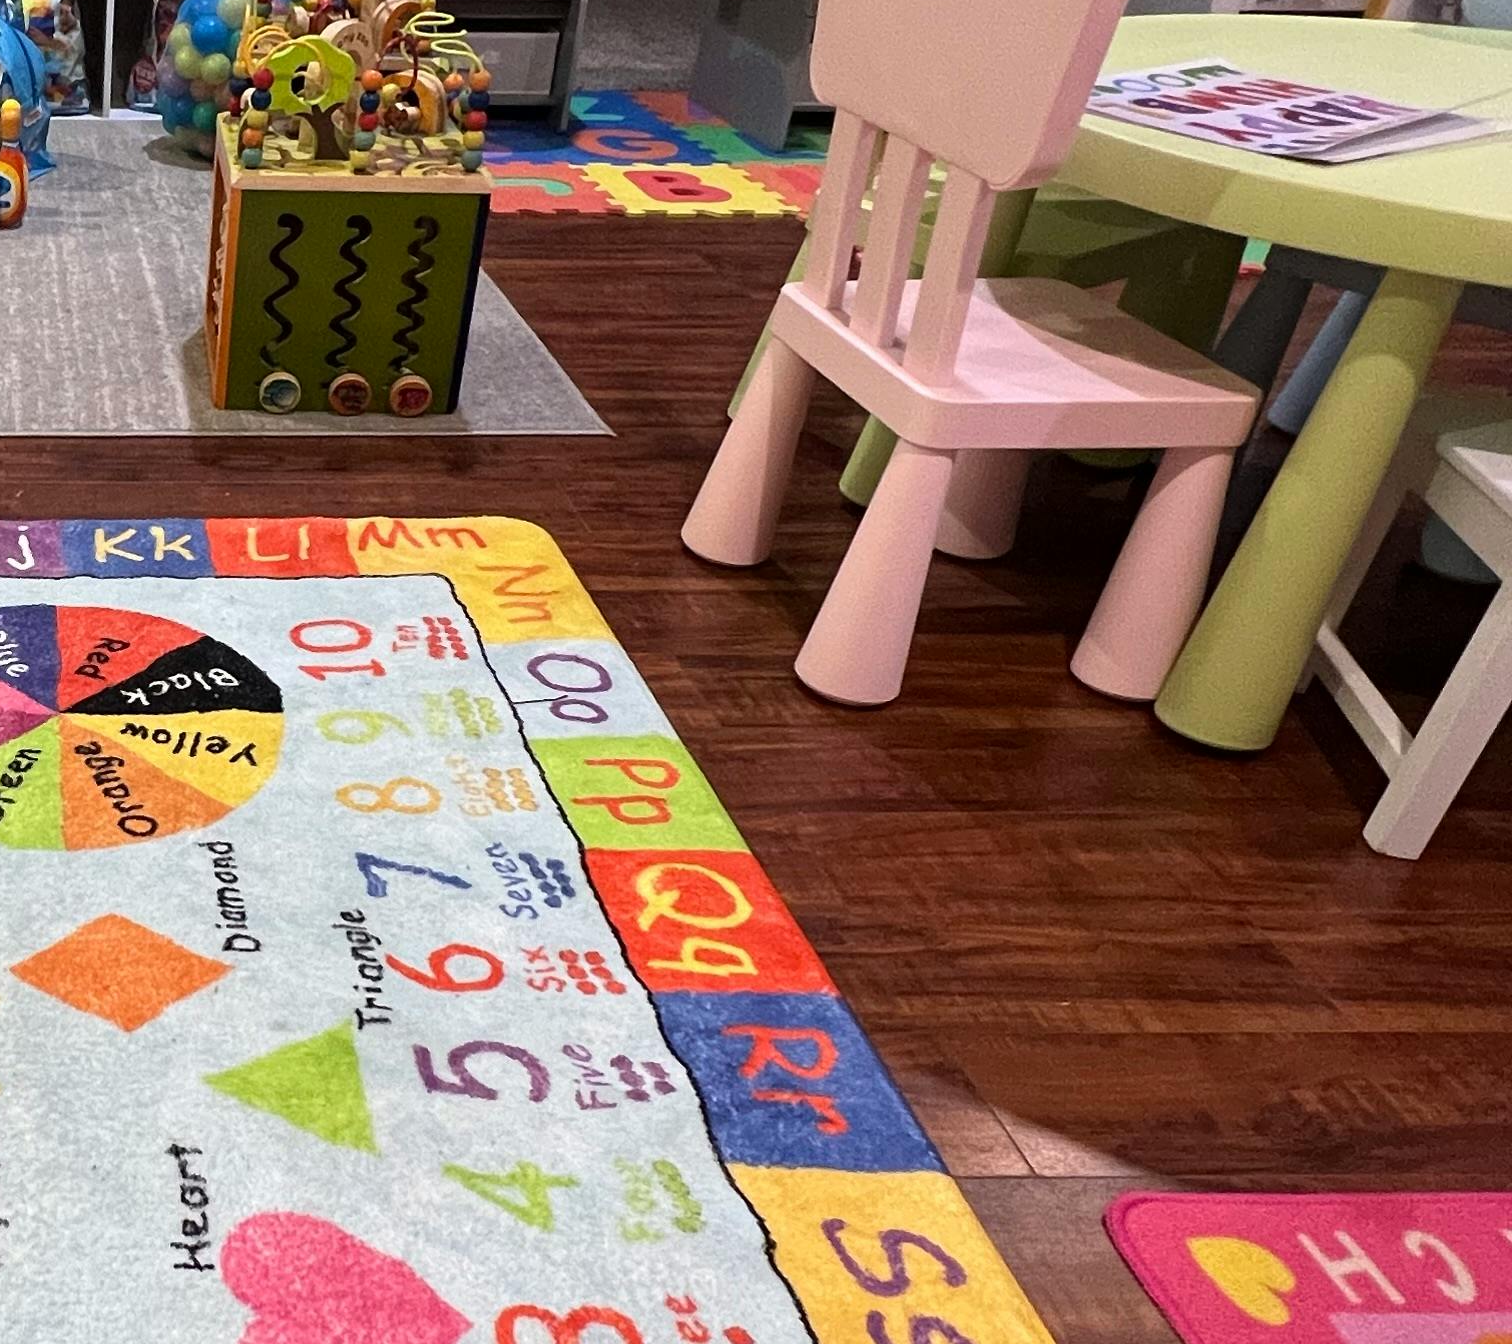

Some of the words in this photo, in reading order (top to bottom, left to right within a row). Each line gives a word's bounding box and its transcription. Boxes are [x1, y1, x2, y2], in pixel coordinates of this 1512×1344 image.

[572, 128, 680, 160] G
[622, 170, 732, 203] B
[93, 526, 197, 562] Kk
[357, 519, 489, 552] Mm
[476, 563, 561, 625] Nn
[74, 637, 130, 681] Red
[289, 618, 389, 681] 10
[392, 623, 421, 653] Ten
[121, 666, 241, 706] Black
[526, 652, 613, 725] Oo
[120, 721, 260, 768] Yellow
[316, 708, 413, 745] 9
[74, 740, 159, 838] Orange
[334, 776, 444, 816] 8
[197, 839, 262, 955] Diamond
[355, 851, 475, 900] 7
[486, 840, 540, 923] Seven
[634, 861, 756, 978] Qq
[336, 907, 393, 1031] Triangle
[382, 941, 507, 995] 6
[522, 944, 568, 996] Six
[411, 1039, 553, 1105] 5
[571, 1042, 616, 1114] Five
[720, 1022, 850, 1136] Rr
[165, 1142, 218, 1275] Heart
[441, 1159, 580, 1235] 4
